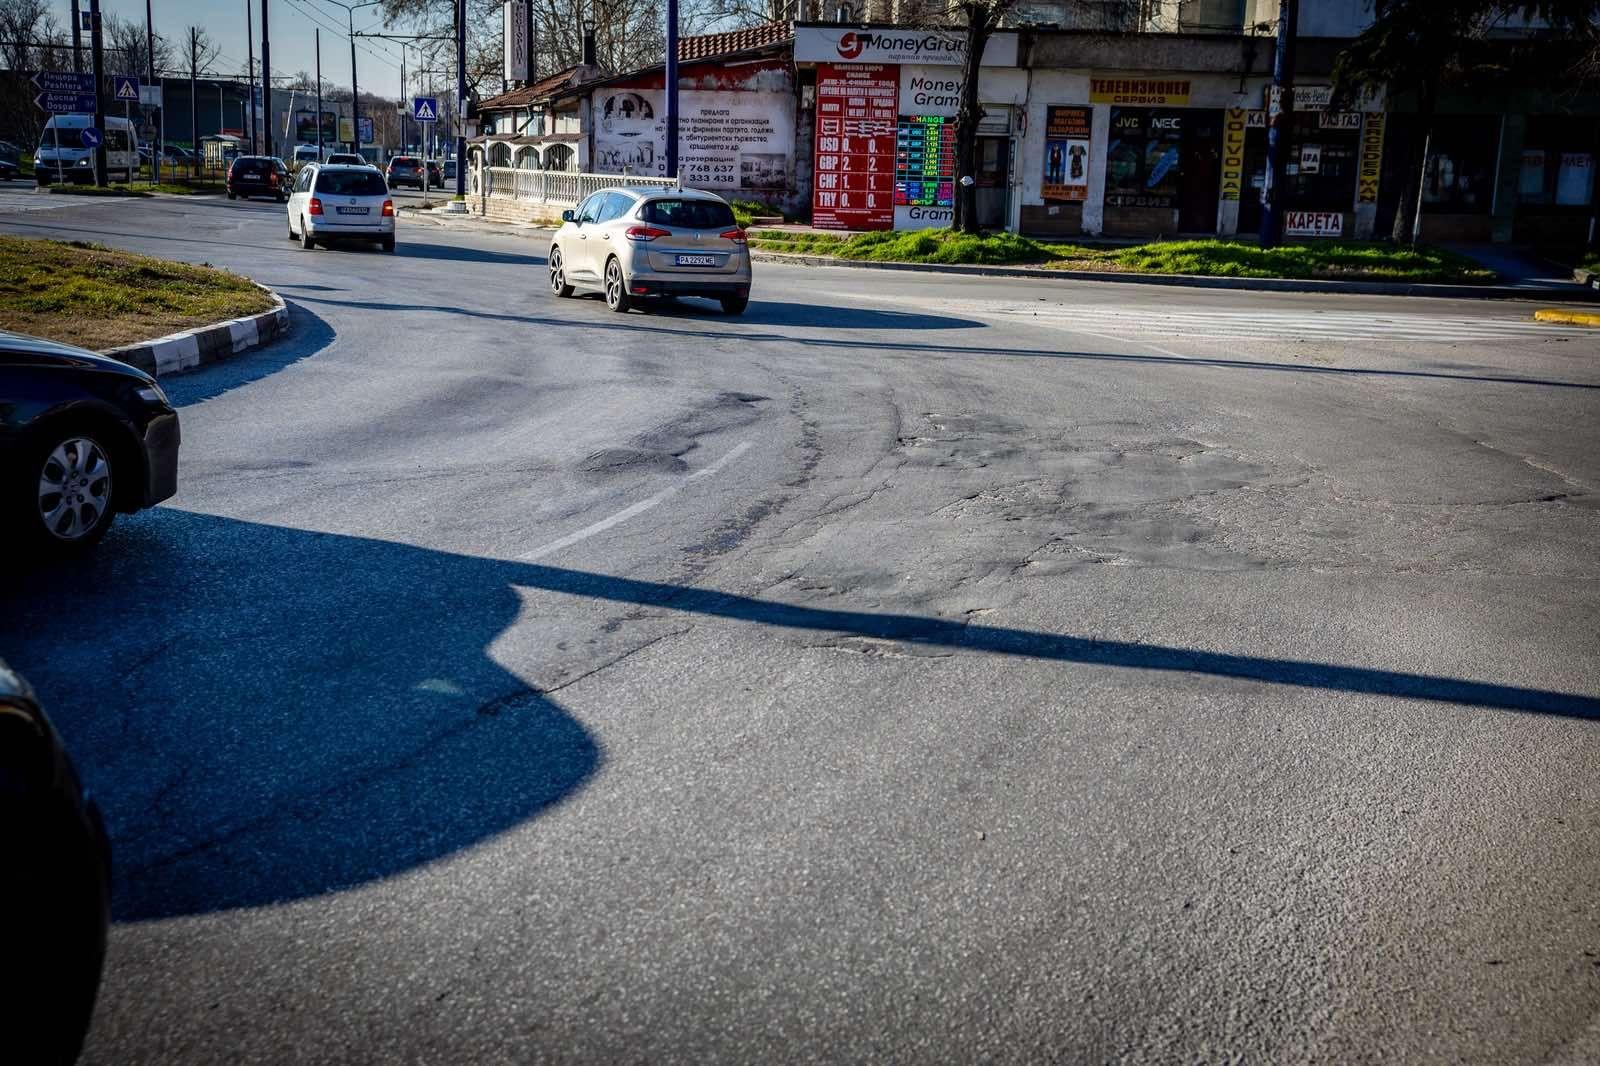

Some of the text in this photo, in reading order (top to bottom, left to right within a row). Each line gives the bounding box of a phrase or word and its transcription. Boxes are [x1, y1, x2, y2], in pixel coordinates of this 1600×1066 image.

[44, 81, 82, 90] Peshtera
[910, 78, 963, 95] Money
[47, 95, 78, 103] Доспат
[914, 93, 960, 106] Gram
[1113, 96, 1166, 104] СЕРВИЗ
[47, 102, 76, 111] Dospat
[910, 116, 945, 124] CHANGE
[1115, 118, 1140, 128] JVC
[1152, 118, 1182, 128] NEC
[820, 137, 839, 152] USD
[1225, 109, 1244, 167] VOLVO
[690, 164, 711, 172] 768
[713, 164, 735, 172] 637
[819, 156, 839, 170] GBP
[690, 174, 711, 183] 333
[713, 174, 734, 183] 438
[819, 174, 838, 189] CHF
[818, 192, 837, 207] TRY
[1105, 195, 1172, 208] СЕРВИЗ
[909, 207, 954, 221] Gram
[1287, 212, 1341, 230] КАРЕТА
